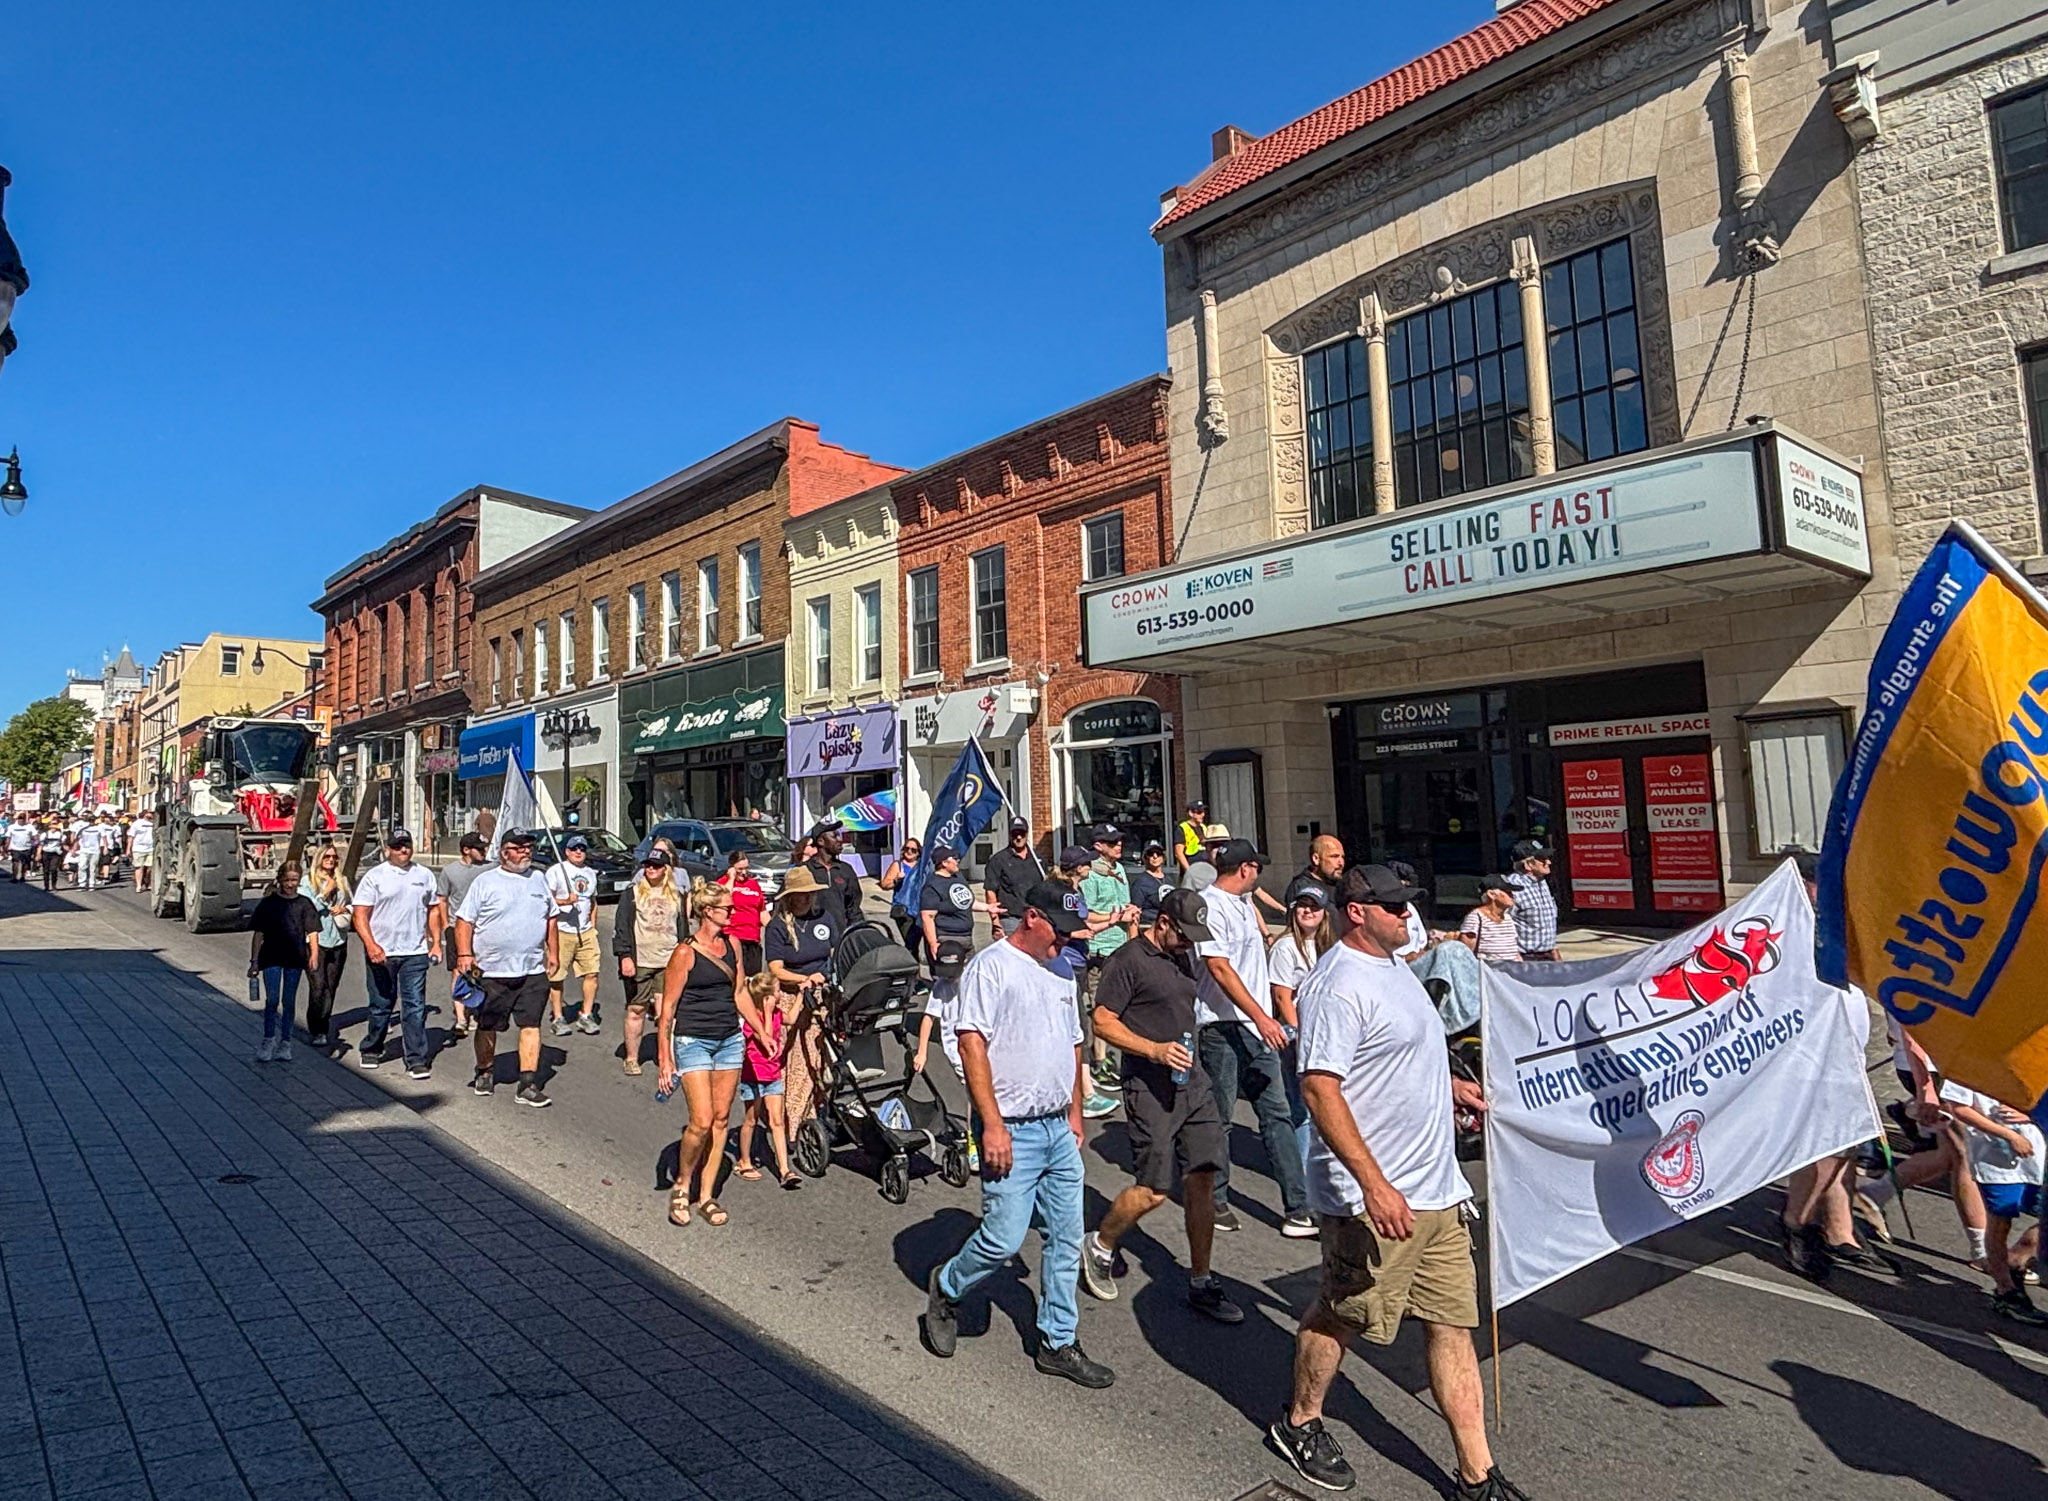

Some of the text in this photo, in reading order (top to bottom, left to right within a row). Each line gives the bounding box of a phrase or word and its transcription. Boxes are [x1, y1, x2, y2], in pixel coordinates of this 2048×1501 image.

[1792, 486, 1859, 531] 613-539-0000
[1391, 487, 1612, 563] SELLING FAST
[1404, 524, 1620, 594] CALL TODAY!
[1204, 566, 1253, 590] KOVEN
[1111, 583, 1169, 610] CROWN
[1136, 598, 1255, 636] 613-539-0000
[1084, 715, 1148, 730] COFFEE BAR
[1381, 701, 1449, 722] CROWN
[1554, 718, 1711, 741] PRIME RETAIL SPACE
[1376, 739, 1459, 754] 223 PRINCESS STREET
[1569, 791, 1619, 799] AVAILABLE
[1650, 787, 1705, 796] AVAILABLE
[1571, 809, 1620, 820] INQUIRE
[1652, 806, 1707, 816] OWN OR
[1577, 821, 1616, 830] TODAY
[1661, 819, 1701, 828] LEASE
[1533, 983, 1668, 1048] LOCAL
[1516, 984, 1765, 1111] international union of
[1589, 1007, 1805, 1134] operating engineers
[1671, 1188, 1715, 1215] ONTARIO
